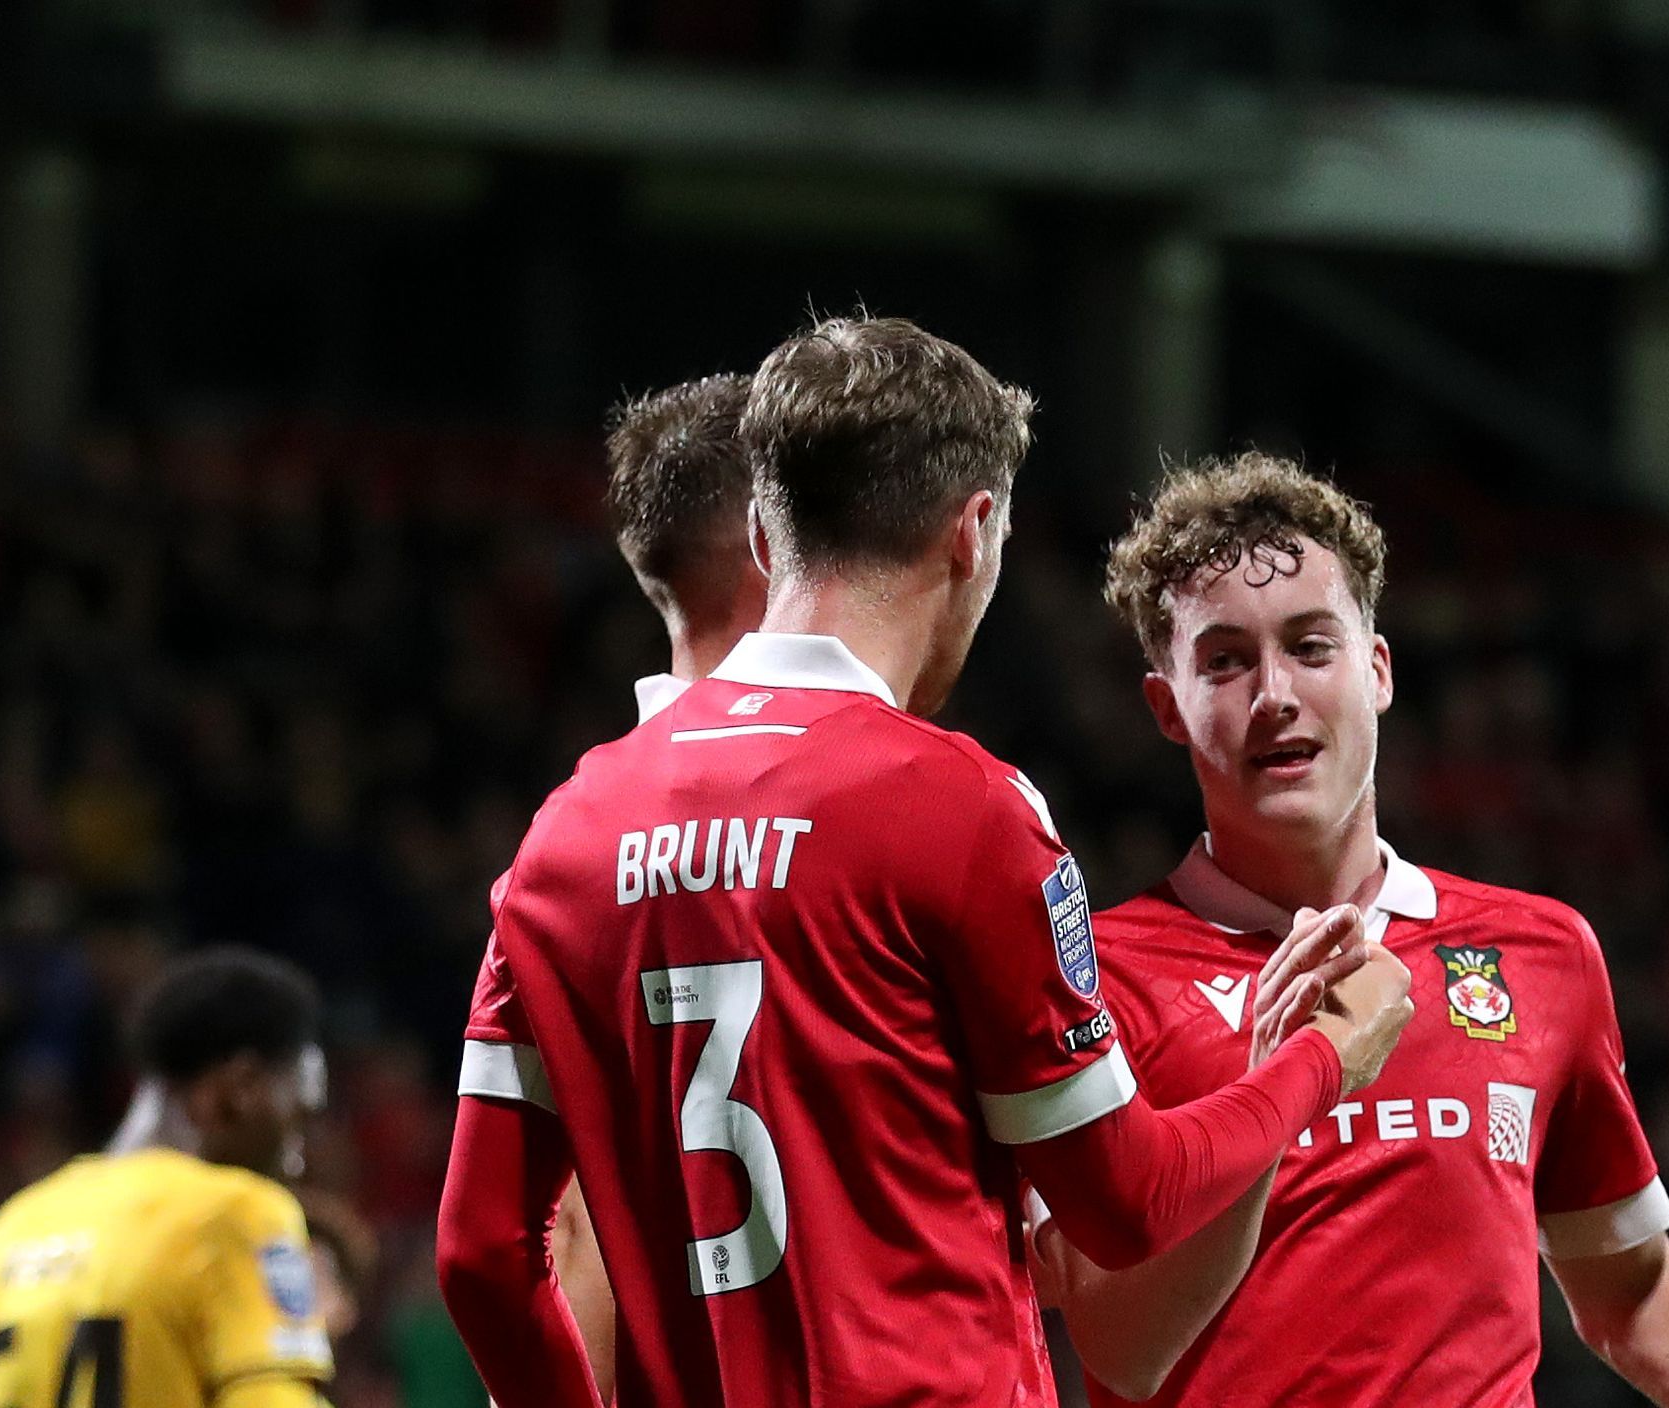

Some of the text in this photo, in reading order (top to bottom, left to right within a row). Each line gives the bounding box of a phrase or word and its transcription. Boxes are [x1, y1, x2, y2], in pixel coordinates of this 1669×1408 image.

[616, 817, 813, 906] BRUNT
[1051, 887, 1085, 922] BRISTOL
[1056, 905, 1085, 938] STREET
[1060, 925, 1087, 953] MOTORS
[1063, 941, 1090, 967] TROPHY
[1065, 1009, 1111, 1050] TOGE
[640, 960, 789, 1296] 3
[1298, 1097, 1471, 1148] TED
[715, 1273, 730, 1284] EFL
